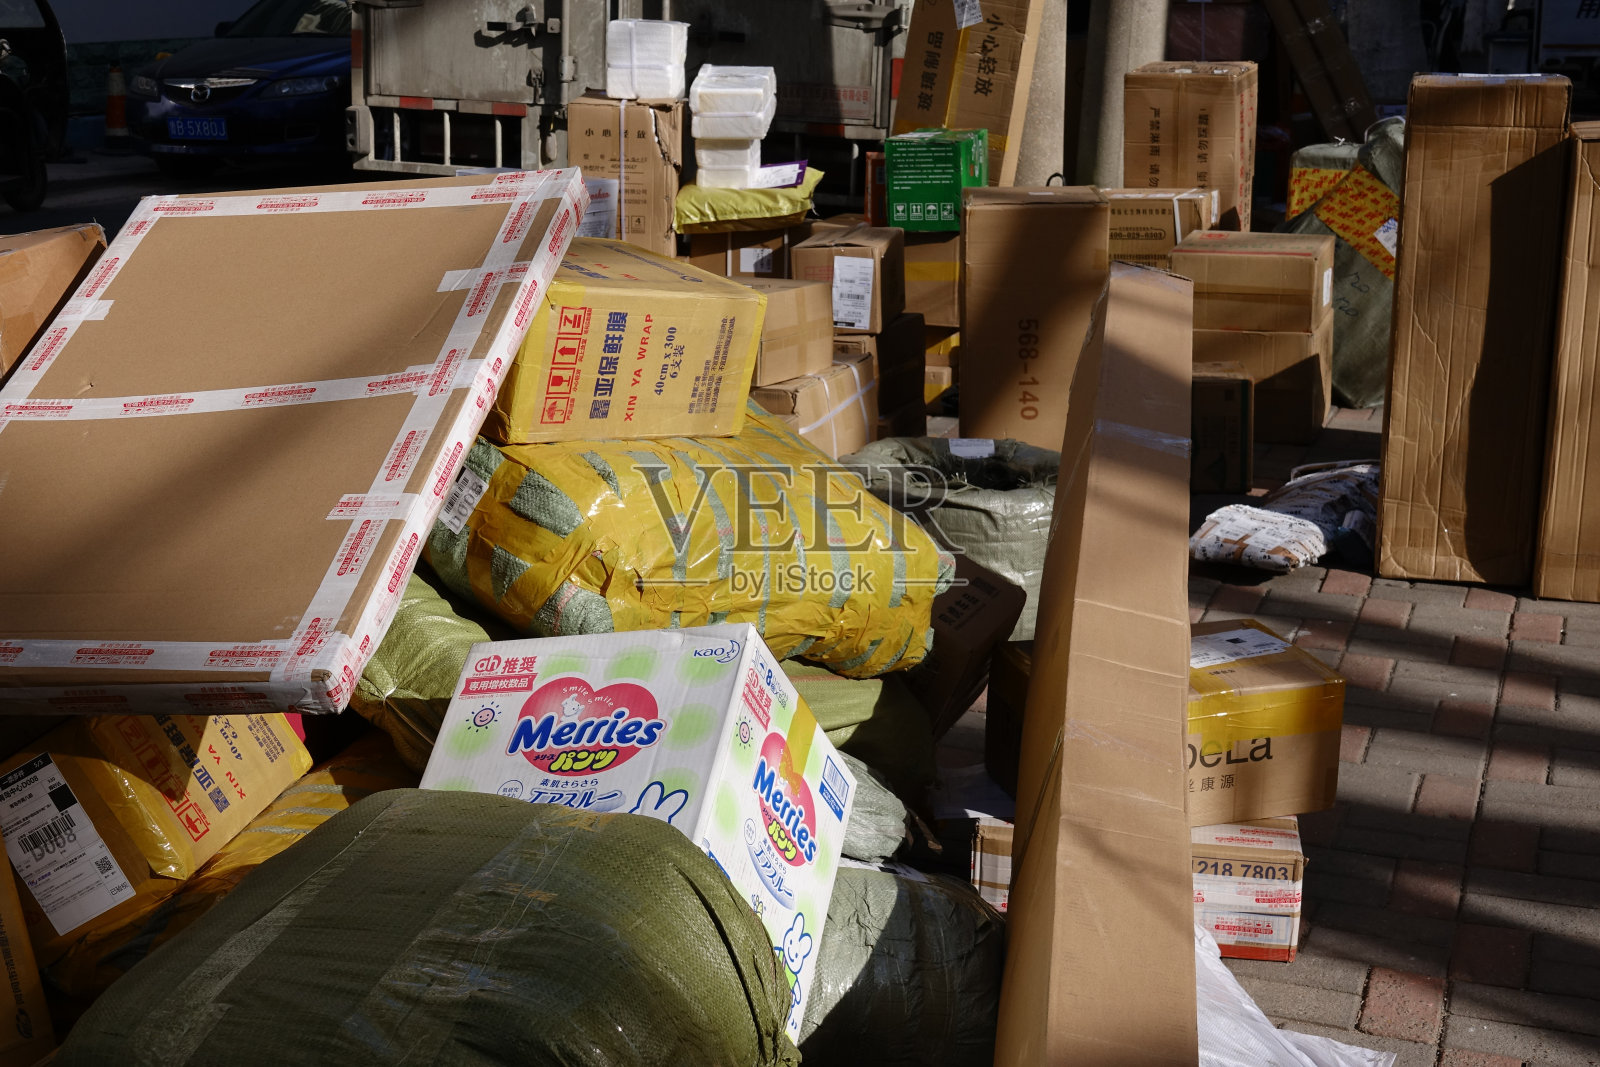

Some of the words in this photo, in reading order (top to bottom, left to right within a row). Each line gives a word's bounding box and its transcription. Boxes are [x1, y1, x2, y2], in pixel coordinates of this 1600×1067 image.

[974, 13, 1004, 97] 小心轻放
[589, 311, 629, 419] 鑫亚保鲜膜
[623, 395, 638, 422] XIN
[631, 368, 643, 389] YA
[637, 313, 654, 361] WRAP
[654, 363, 670, 396] 40cm
[664, 326, 677, 350] 300
[1018, 318, 1039, 420] 568-140
[562, 686, 589, 697] smile
[587, 695, 613, 707] smile
[219, 728, 243, 761] 40cm
[508, 711, 663, 754] Merries
[208, 744, 221, 765] YA
[549, 749, 618, 773] パンツ
[225, 771, 247, 800] XIN
[539, 778, 599, 788] 素肌さらさら
[753, 759, 817, 862] Merries
[767, 819, 797, 861] パンツ
[754, 844, 793, 898] エアスルー
[1240, 863, 1289, 880] 7803
